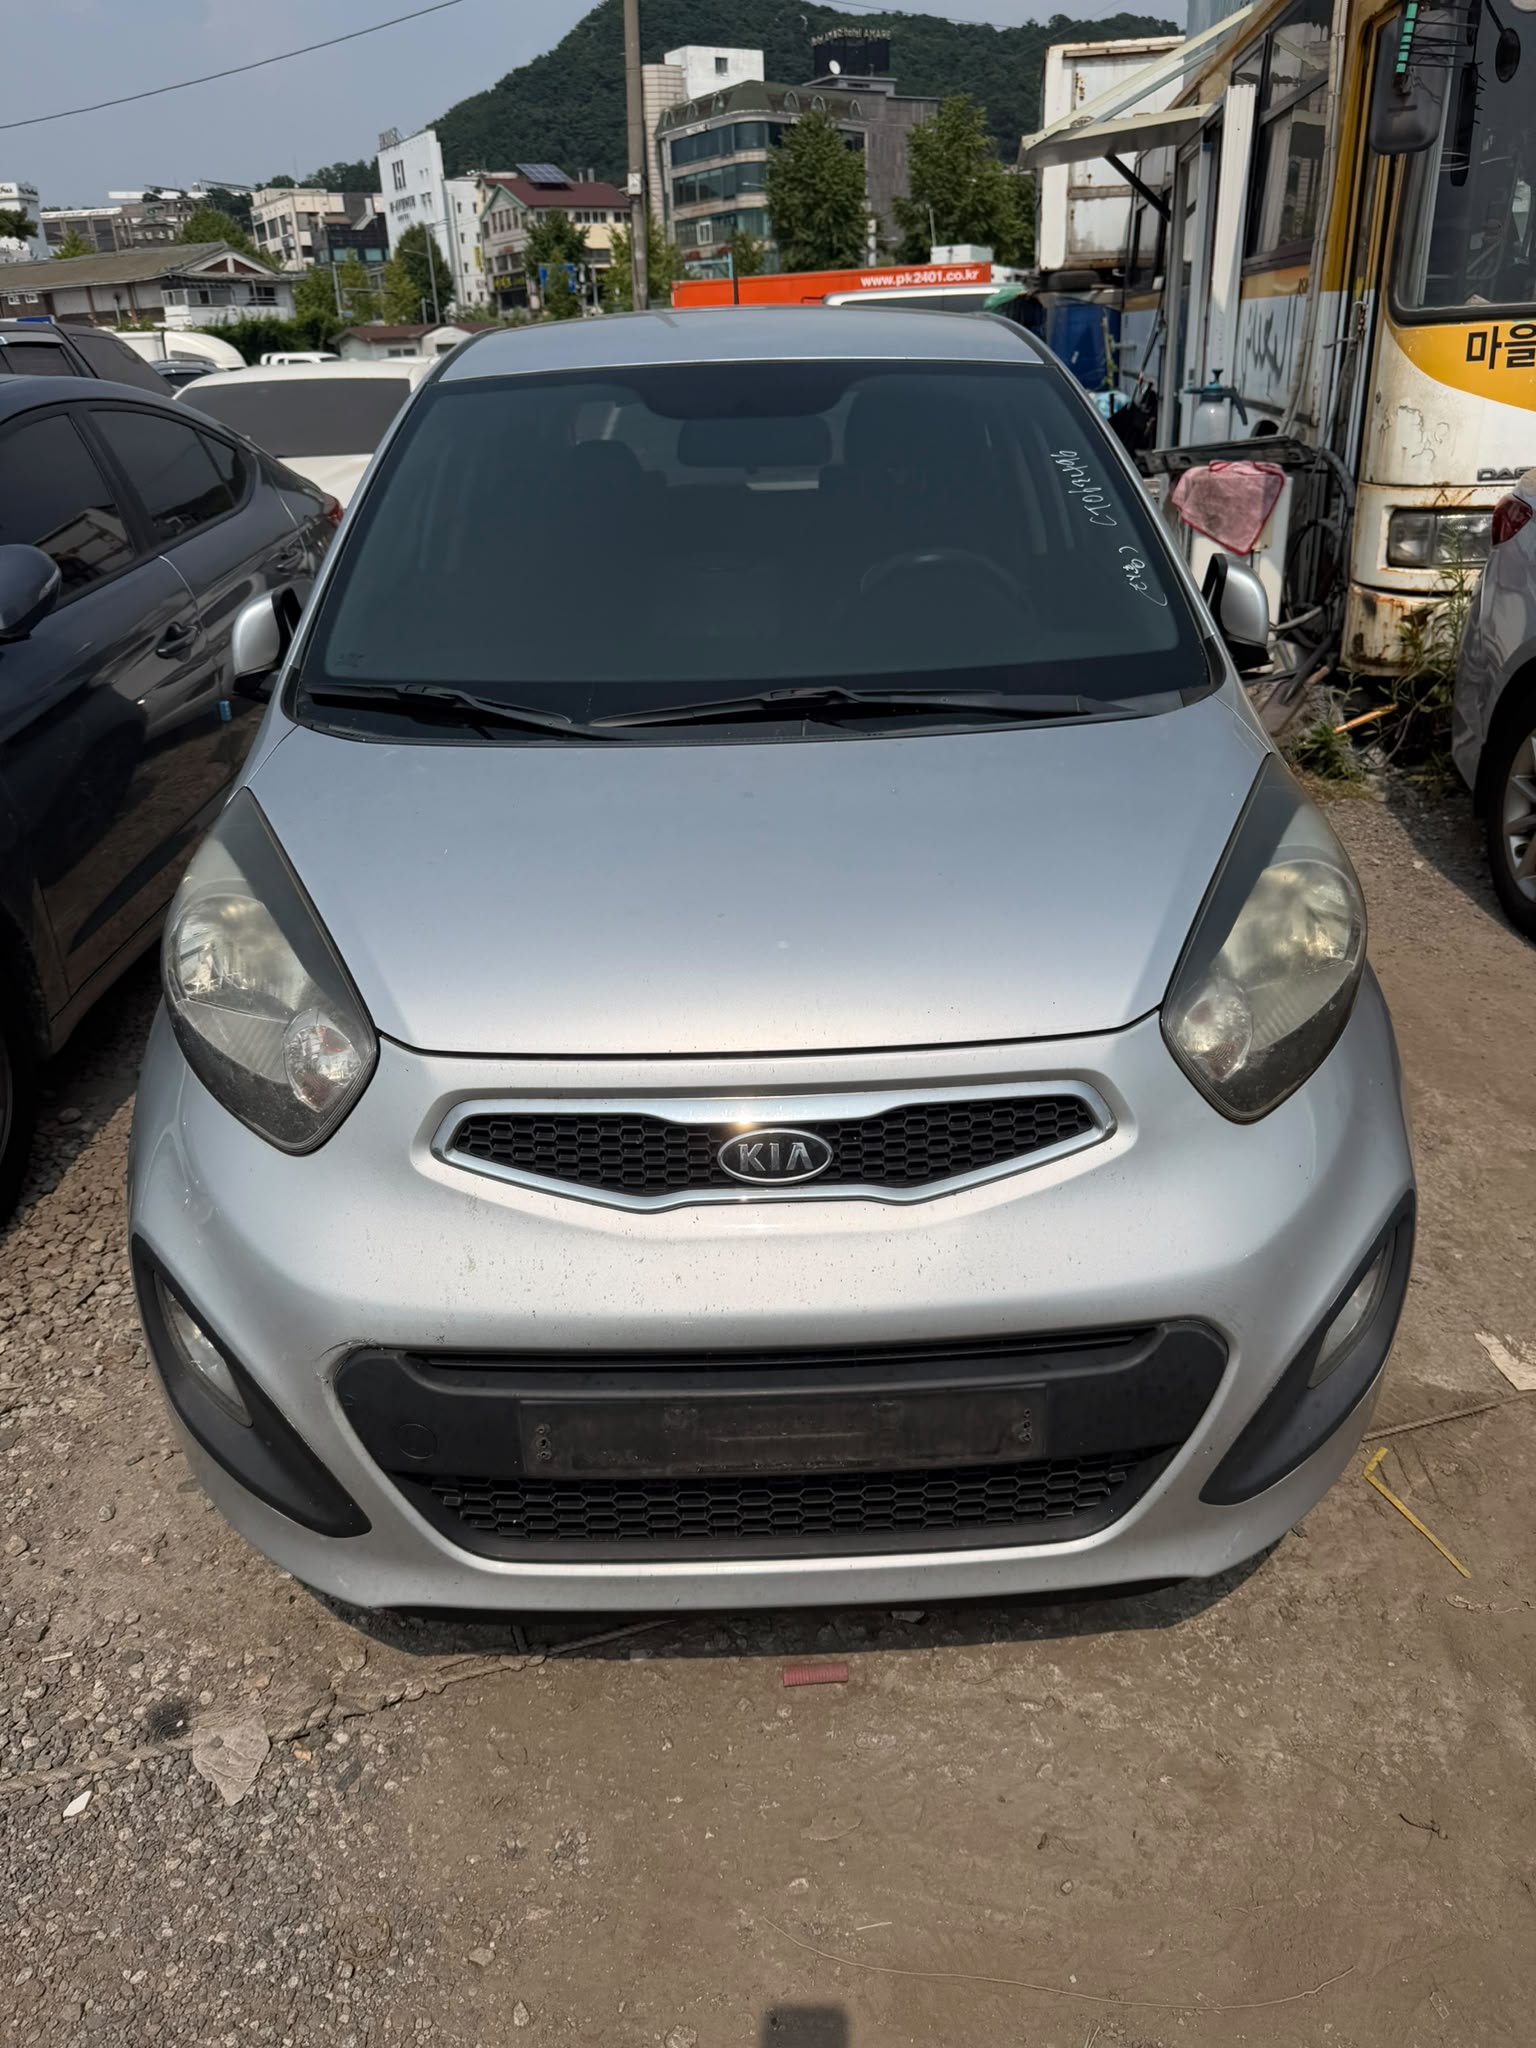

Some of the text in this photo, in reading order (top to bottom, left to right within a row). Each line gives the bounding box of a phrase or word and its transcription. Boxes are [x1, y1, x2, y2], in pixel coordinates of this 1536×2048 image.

[861, 268, 979, 288] www.pk2401.co.kr
[1466, 324, 1536, 370] 마을
[738, 1142, 814, 1172] KIA
